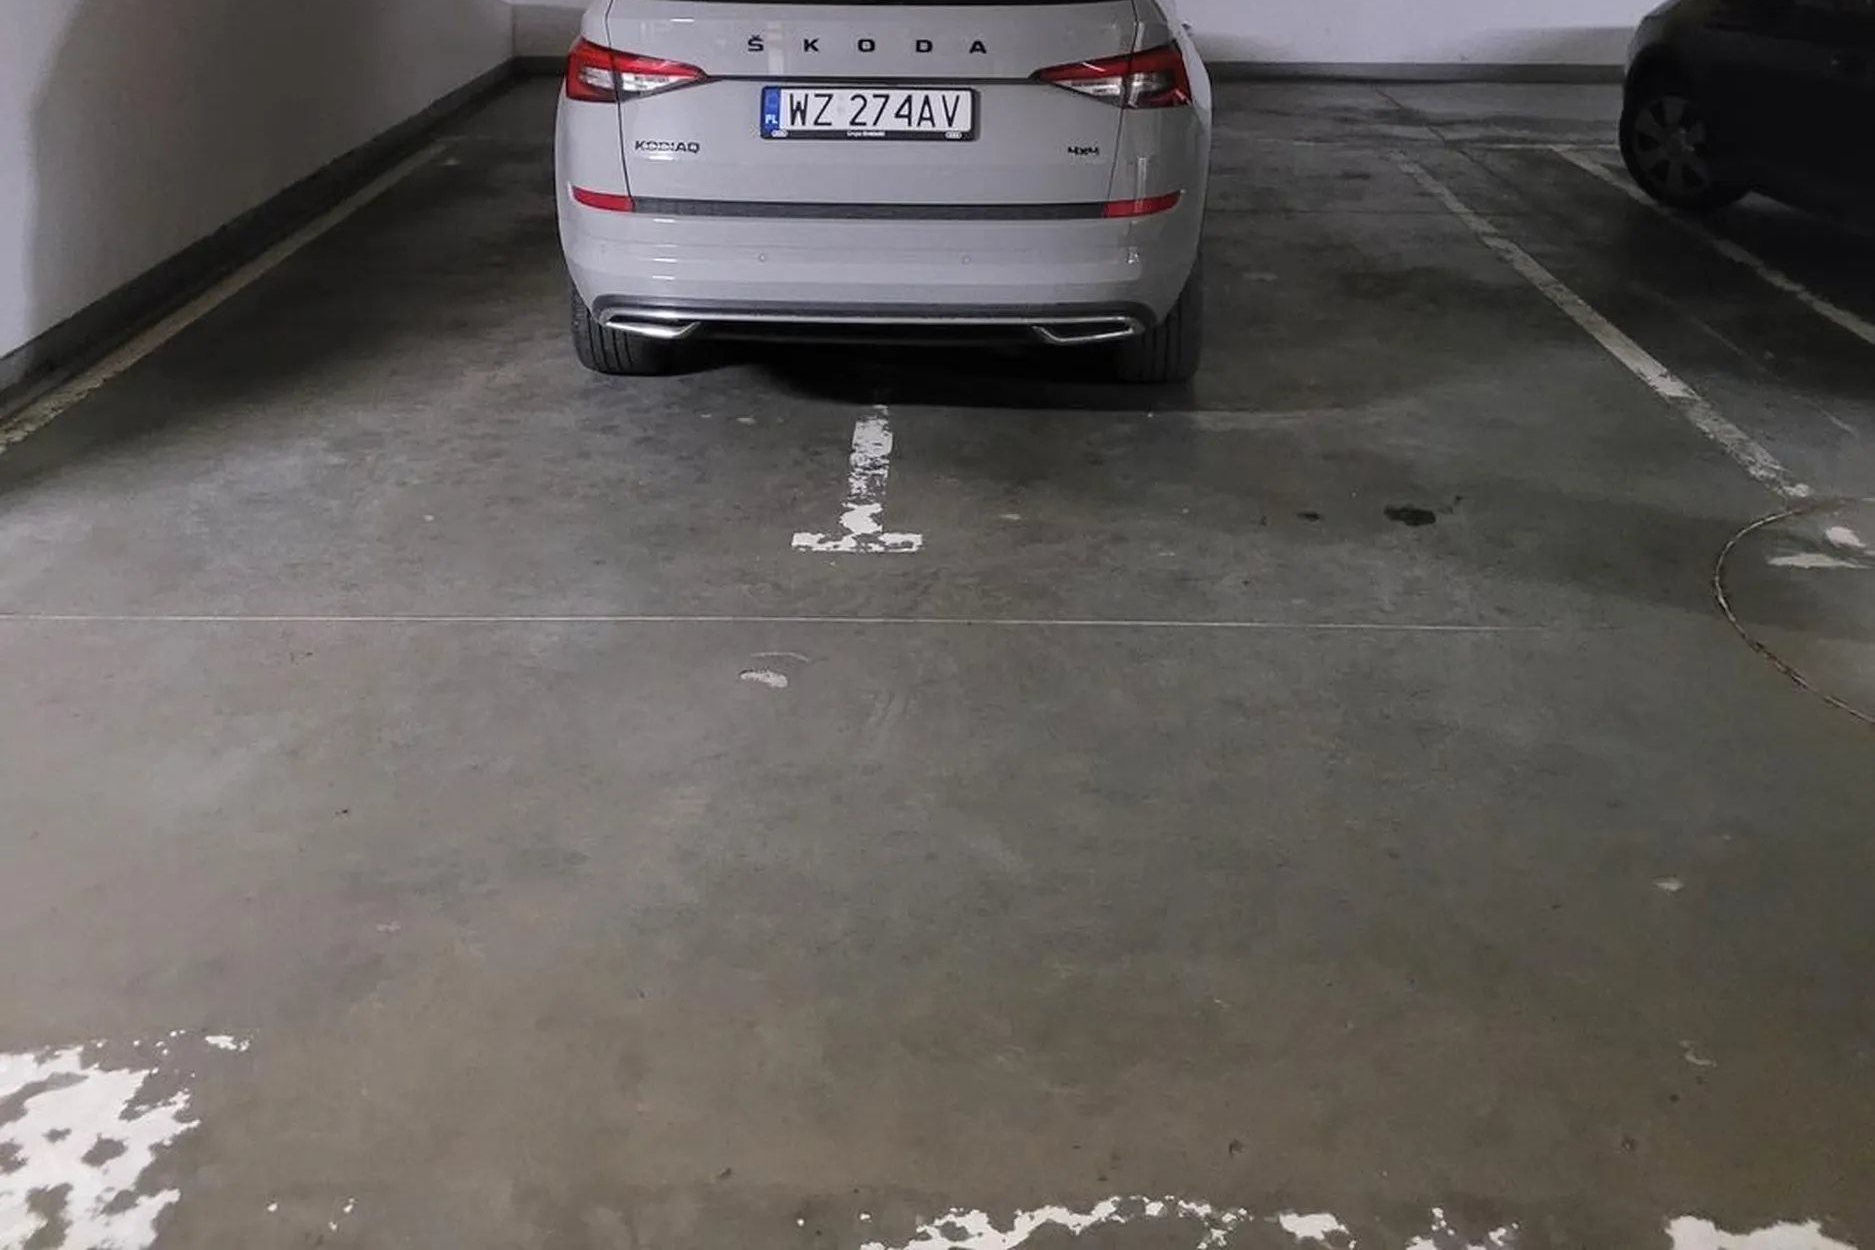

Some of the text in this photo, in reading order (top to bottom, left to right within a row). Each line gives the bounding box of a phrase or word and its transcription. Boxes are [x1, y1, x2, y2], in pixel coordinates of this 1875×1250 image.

[747, 35, 987, 54] ŠKODA
[790, 93, 959, 127] WZ 274AV
[765, 114, 778, 124] PL
[635, 140, 700, 153] KODIAQ
